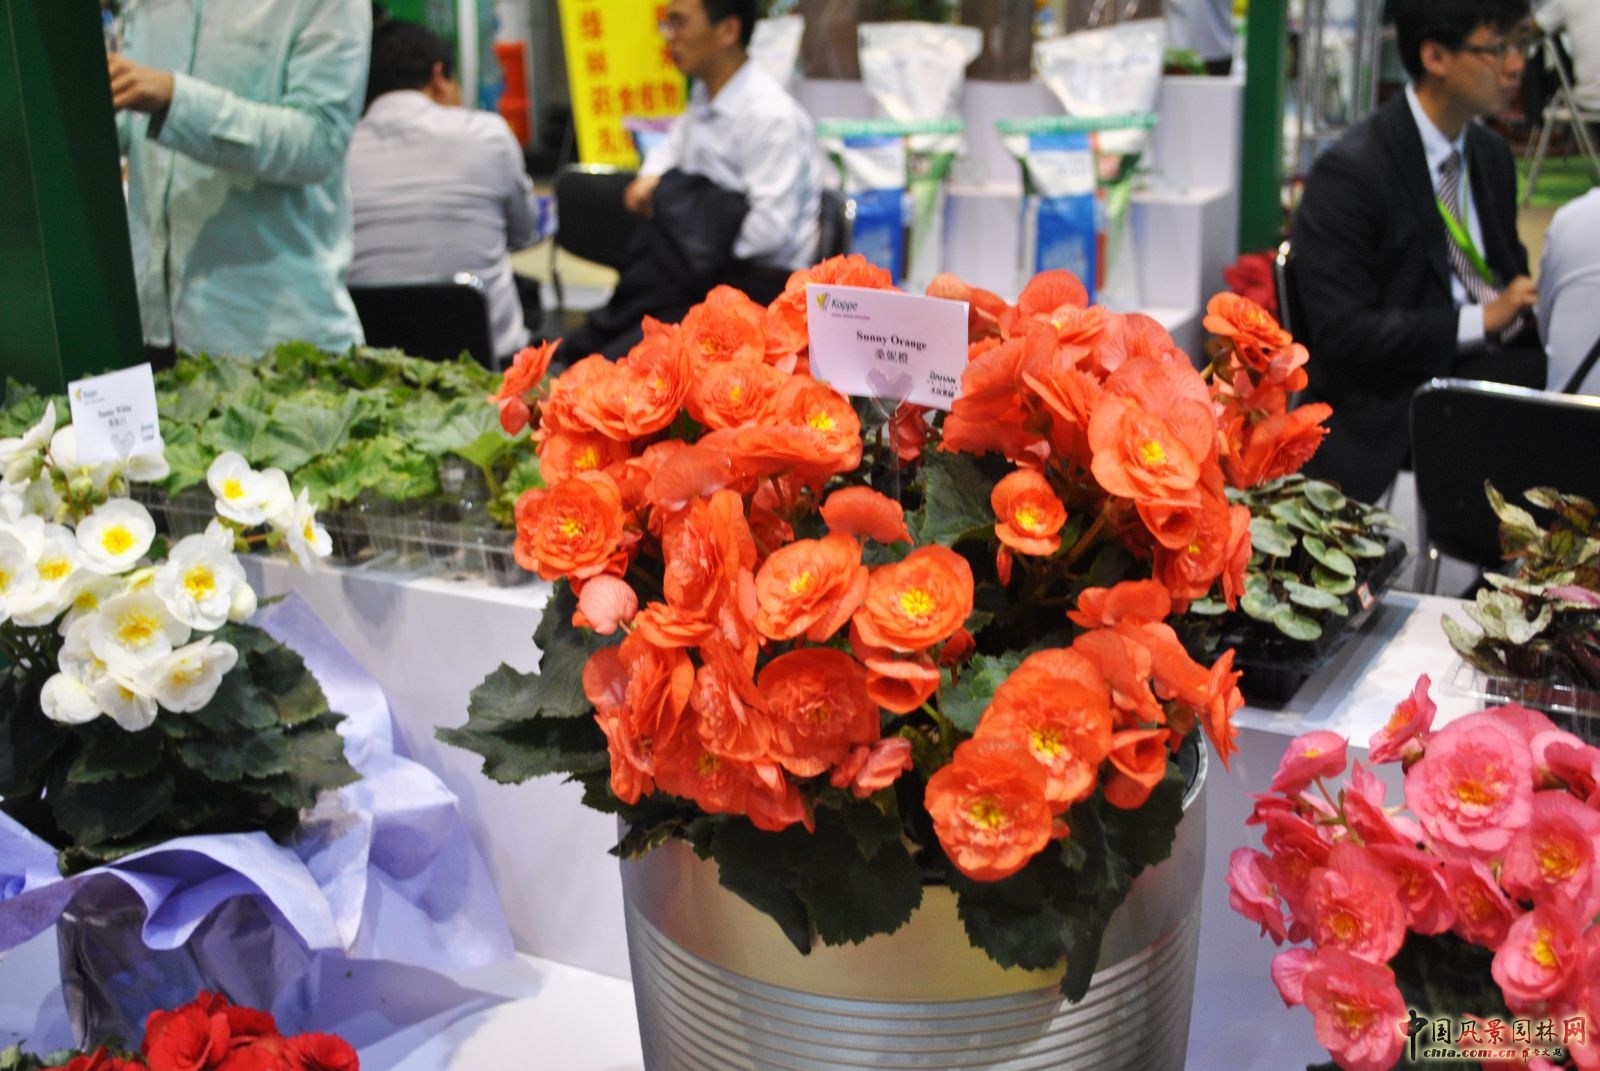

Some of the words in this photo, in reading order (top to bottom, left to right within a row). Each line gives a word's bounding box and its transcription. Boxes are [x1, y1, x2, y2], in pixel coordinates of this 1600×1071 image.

[831, 298, 858, 312] Koppe
[856, 330, 887, 346] Sunny
[890, 334, 928, 350] Orange
